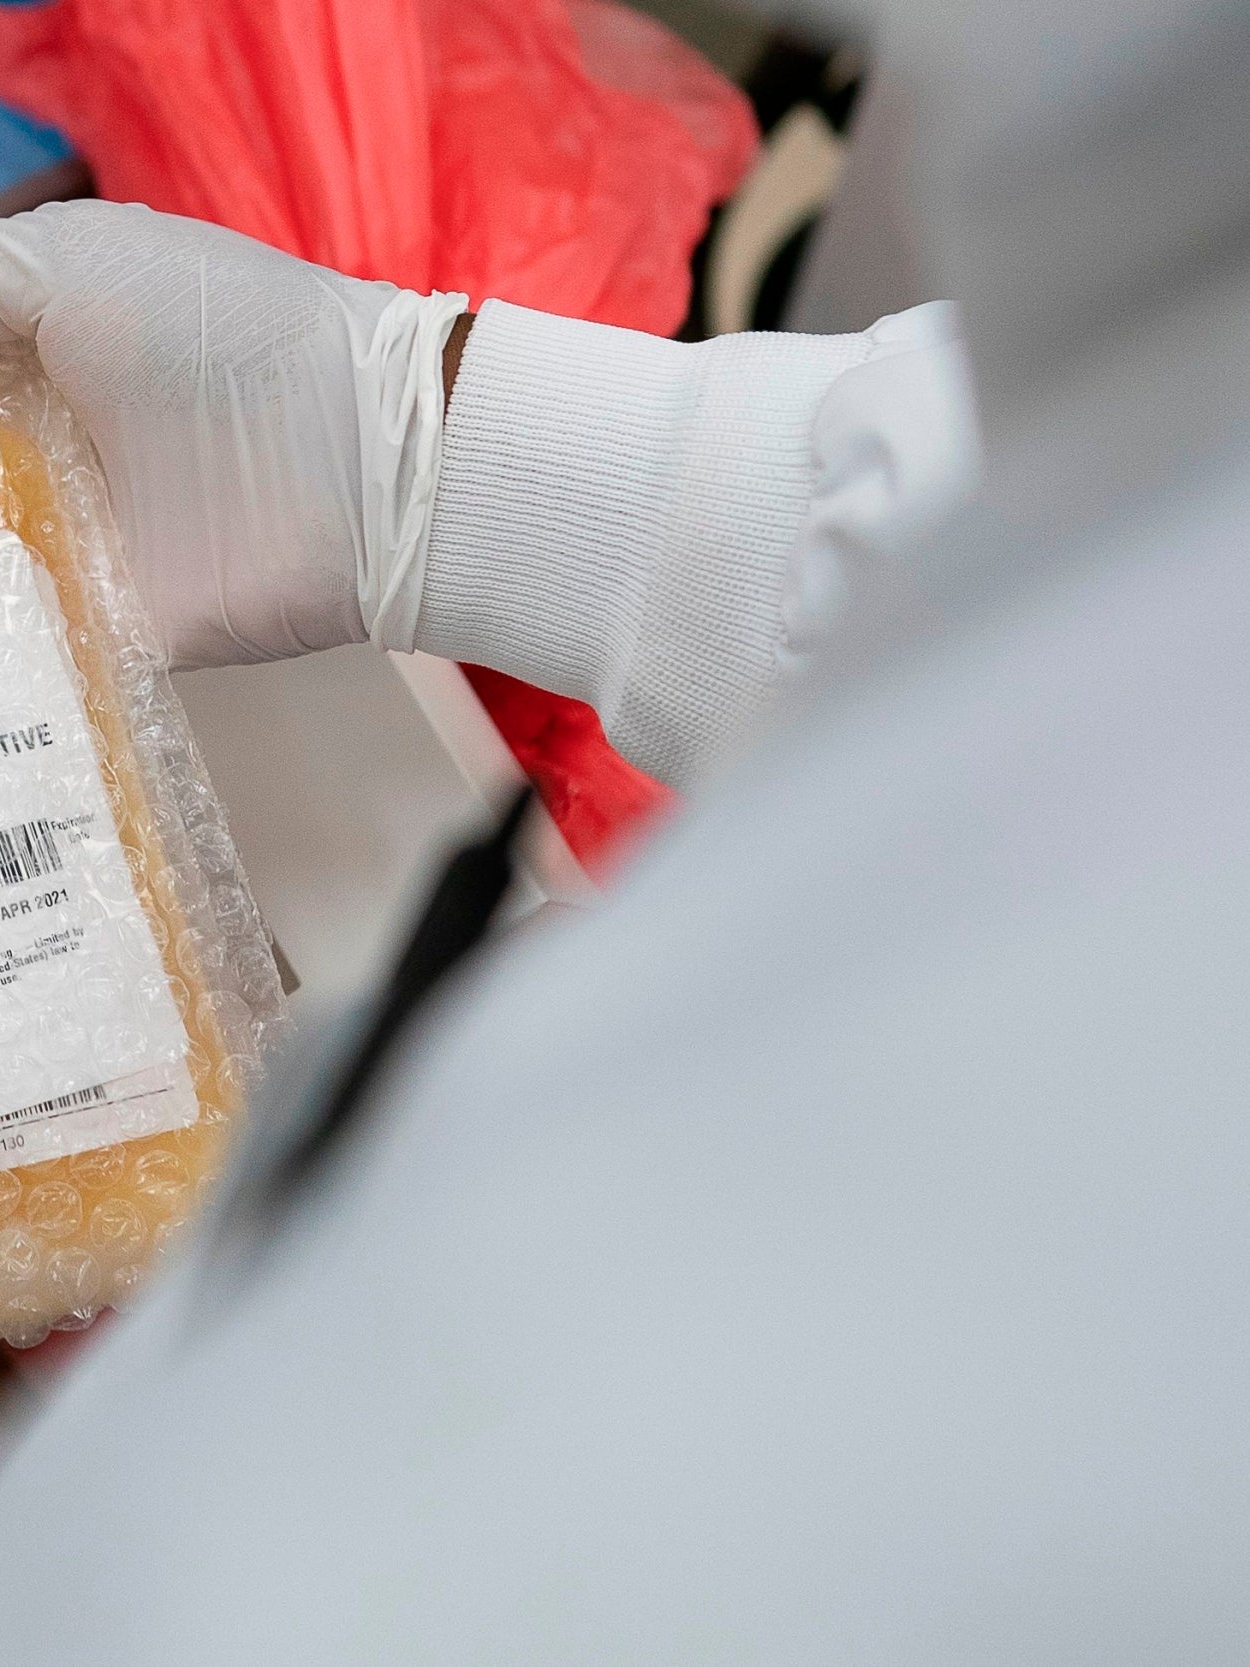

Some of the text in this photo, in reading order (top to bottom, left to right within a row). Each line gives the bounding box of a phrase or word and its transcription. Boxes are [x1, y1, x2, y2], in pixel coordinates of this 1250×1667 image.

[0, 900, 32, 921] APR
[34, 888, 70, 910] 2021
[72, 926, 85, 938] by
[13, 950, 49, 969] States)
